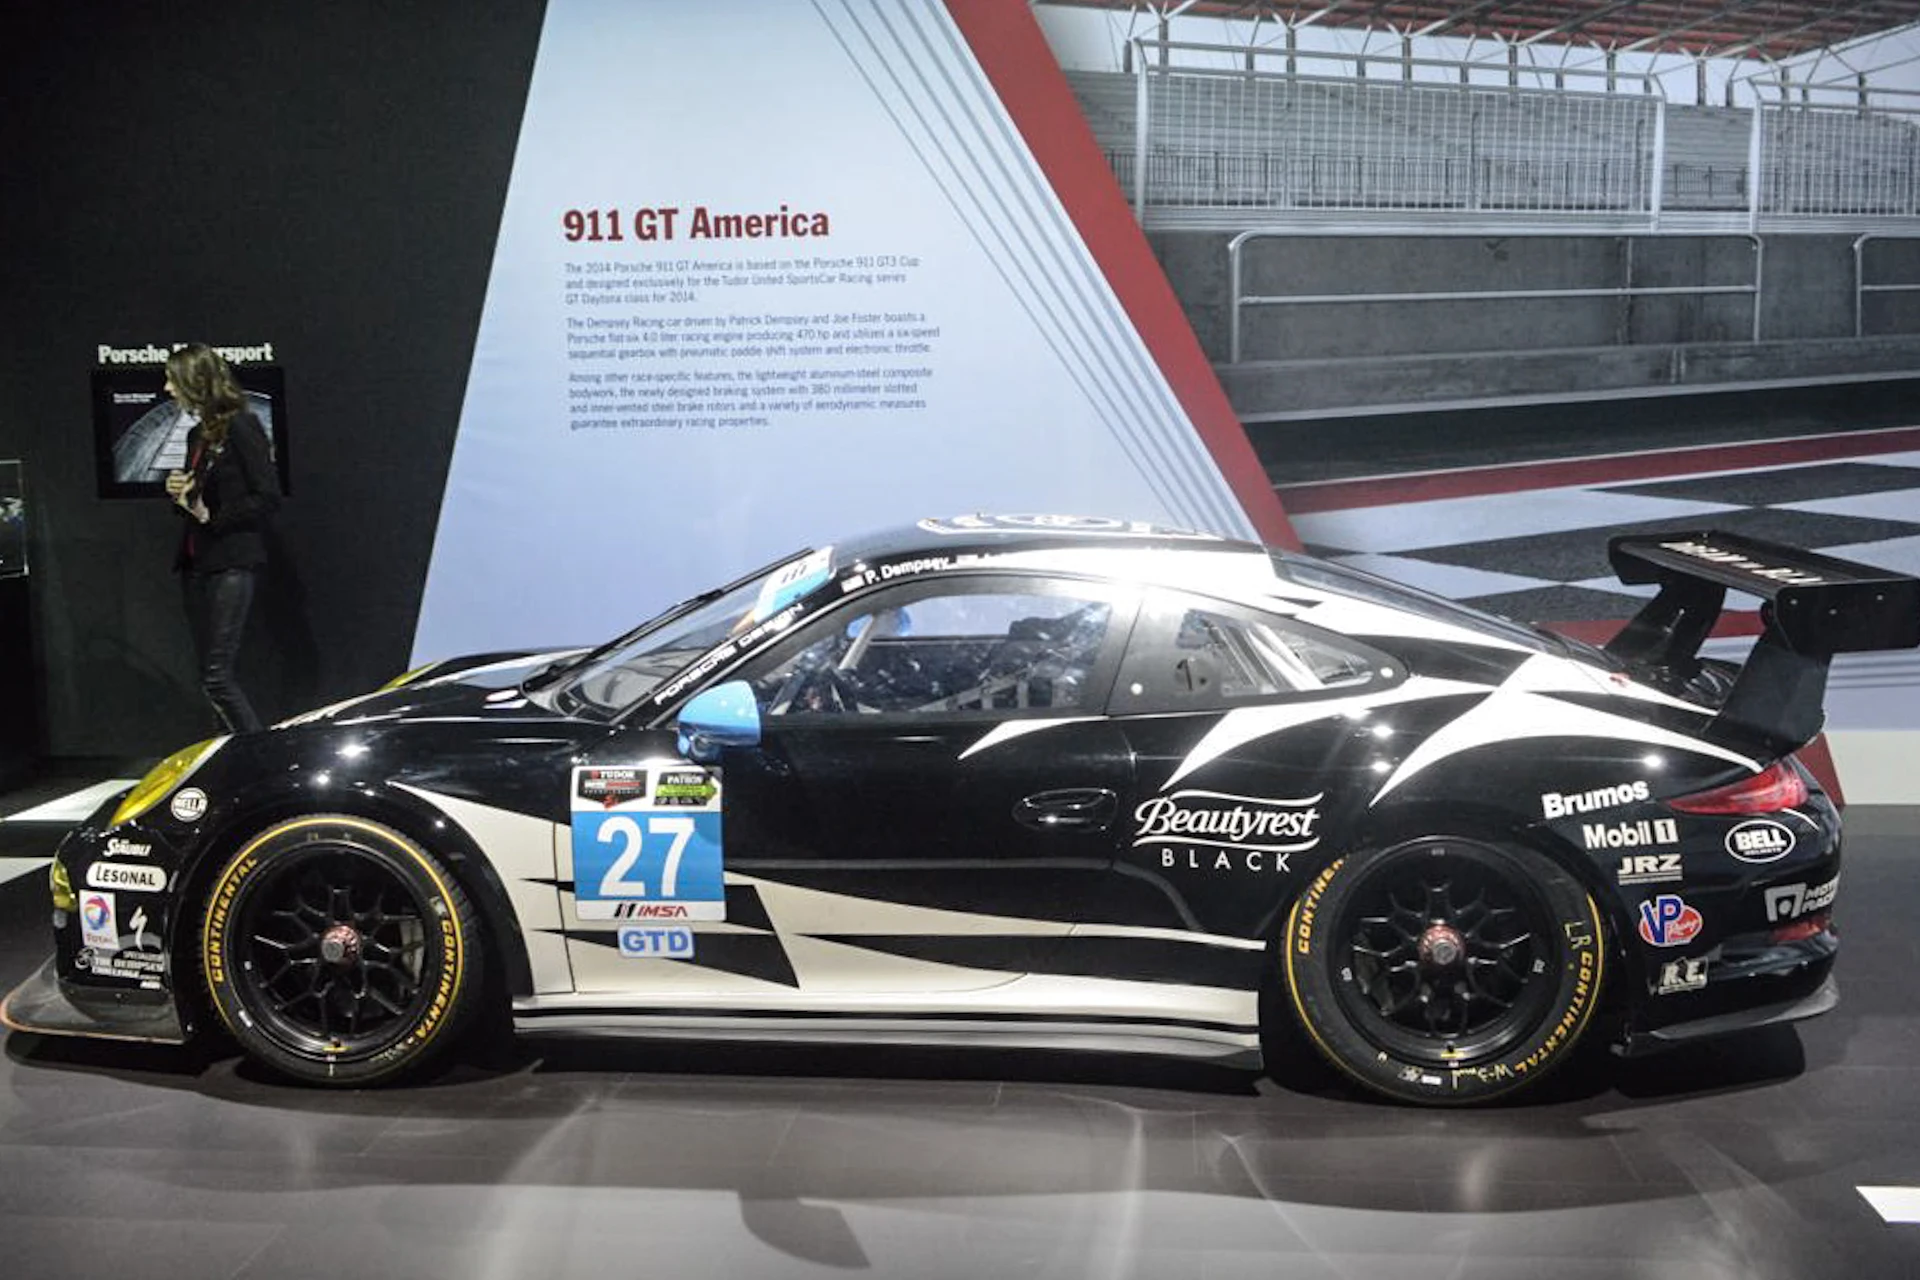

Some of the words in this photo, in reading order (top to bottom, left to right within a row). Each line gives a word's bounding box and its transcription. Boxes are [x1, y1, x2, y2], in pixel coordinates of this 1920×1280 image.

[563, 208, 623, 243] 911
[634, 207, 678, 241] GT
[690, 204, 830, 239] America
[565, 262, 581, 273] The
[614, 261, 653, 272] Porsche
[656, 261, 674, 272] 911
[676, 260, 689, 272] GT
[692, 260, 732, 271] America
[746, 258, 776, 270] based
[795, 258, 810, 269] the
[813, 257, 853, 269] Porsche
[856, 256, 874, 268] 911
[877, 255, 896, 267] GT3
[566, 279, 583, 289] and
[585, 278, 629, 290] designed
[632, 277, 684, 289] exclusively
[687, 276, 700, 287] for
[703, 275, 719, 286] the
[722, 274, 748, 286] Tudor
[787, 273, 836, 286] SportsCar
[839, 272, 873, 285] Racing
[566, 294, 579, 306] GT
[624, 292, 650, 304] class
[653, 291, 667, 303] for
[567, 317, 583, 328] The
[633, 316, 664, 329] Racing
[666, 318, 681, 327] car
[729, 314, 761, 326] Patrick
[811, 313, 829, 324] and
[832, 313, 849, 324] Joe
[852, 312, 881, 323] Foster
[567, 333, 606, 344] Porsche
[832, 328, 850, 339] and
[98, 344, 170, 364] Porsche
[825, 344, 843, 355] and
[737, 369, 752, 380] the
[620, 387, 635, 398] the
[667, 386, 710, 399] designed
[713, 386, 748, 398] braking
[788, 384, 809, 395] with
[570, 403, 588, 413] and
[677, 401, 703, 412] brake
[739, 400, 757, 411] and
[685, 417, 716, 430] racing
[881, 556, 950, 580] Dempsey
[1541, 780, 1650, 819] Brumos
[1134, 797, 1320, 842] Beautyrest
[1582, 821, 1652, 850] Mobil
[1734, 827, 1788, 851] BELL
[596, 816, 695, 897] 27
[1161, 847, 1291, 873] BLACK
[1617, 853, 1682, 875] JRZ
[96, 864, 156, 887] LESONAL
[209, 858, 257, 983] CONTINENTAL
[638, 904, 689, 918] IMSA
[1642, 896, 1684, 944] VP
[622, 930, 689, 952] GTD
[1514, 950, 1594, 1073] CONTINENTAL
